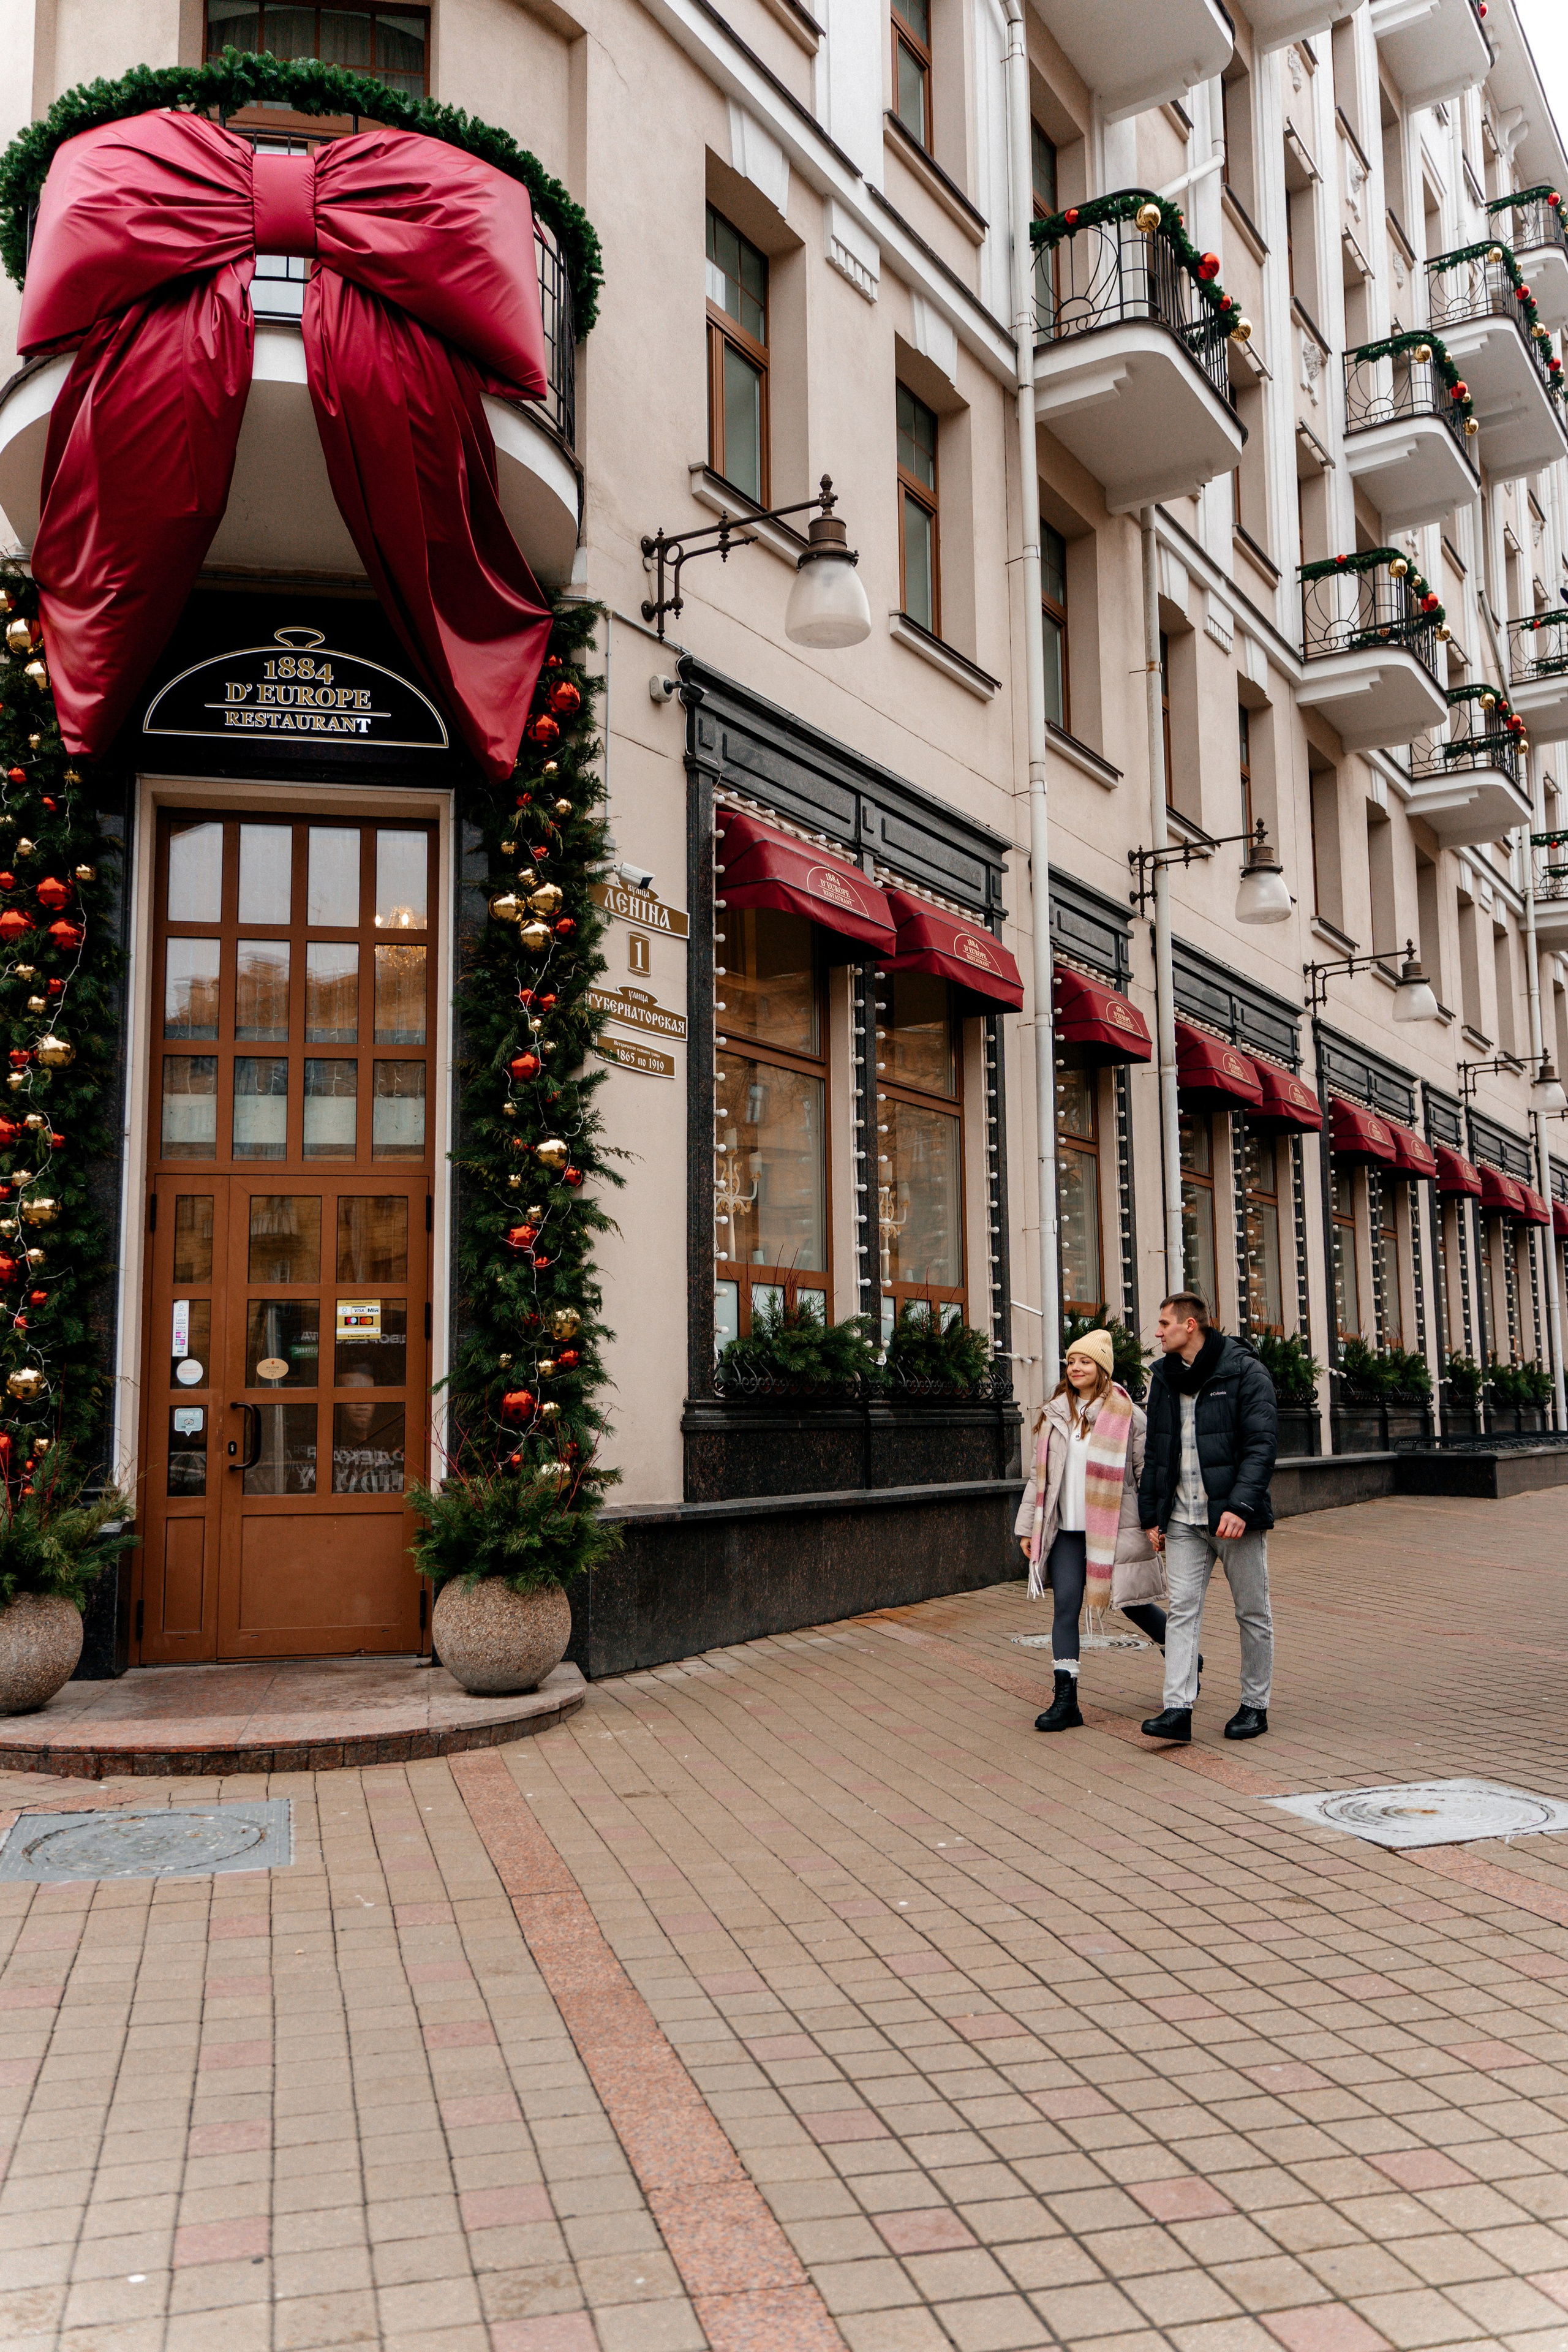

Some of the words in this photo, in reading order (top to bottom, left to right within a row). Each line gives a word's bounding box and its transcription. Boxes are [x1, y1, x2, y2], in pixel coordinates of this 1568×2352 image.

[263, 656, 334, 685] 1884
[225, 710, 371, 733] RESTAURANT
[820, 878, 851, 898] D'EUROPE
[825, 873, 840, 886] 1884
[823, 889, 853, 907] RESTAURANT
[635, 941, 644, 969] 1
[963, 944, 988, 960] D'EUROPE
[628, 990, 649, 1004] улица
[588, 992, 685, 1034] ГУБЕРНАТОРСКАЯ
[614, 1040, 636, 1050] Историческое
[638, 1057, 646, 1067] по
[649, 1058, 665, 1072] 1919
